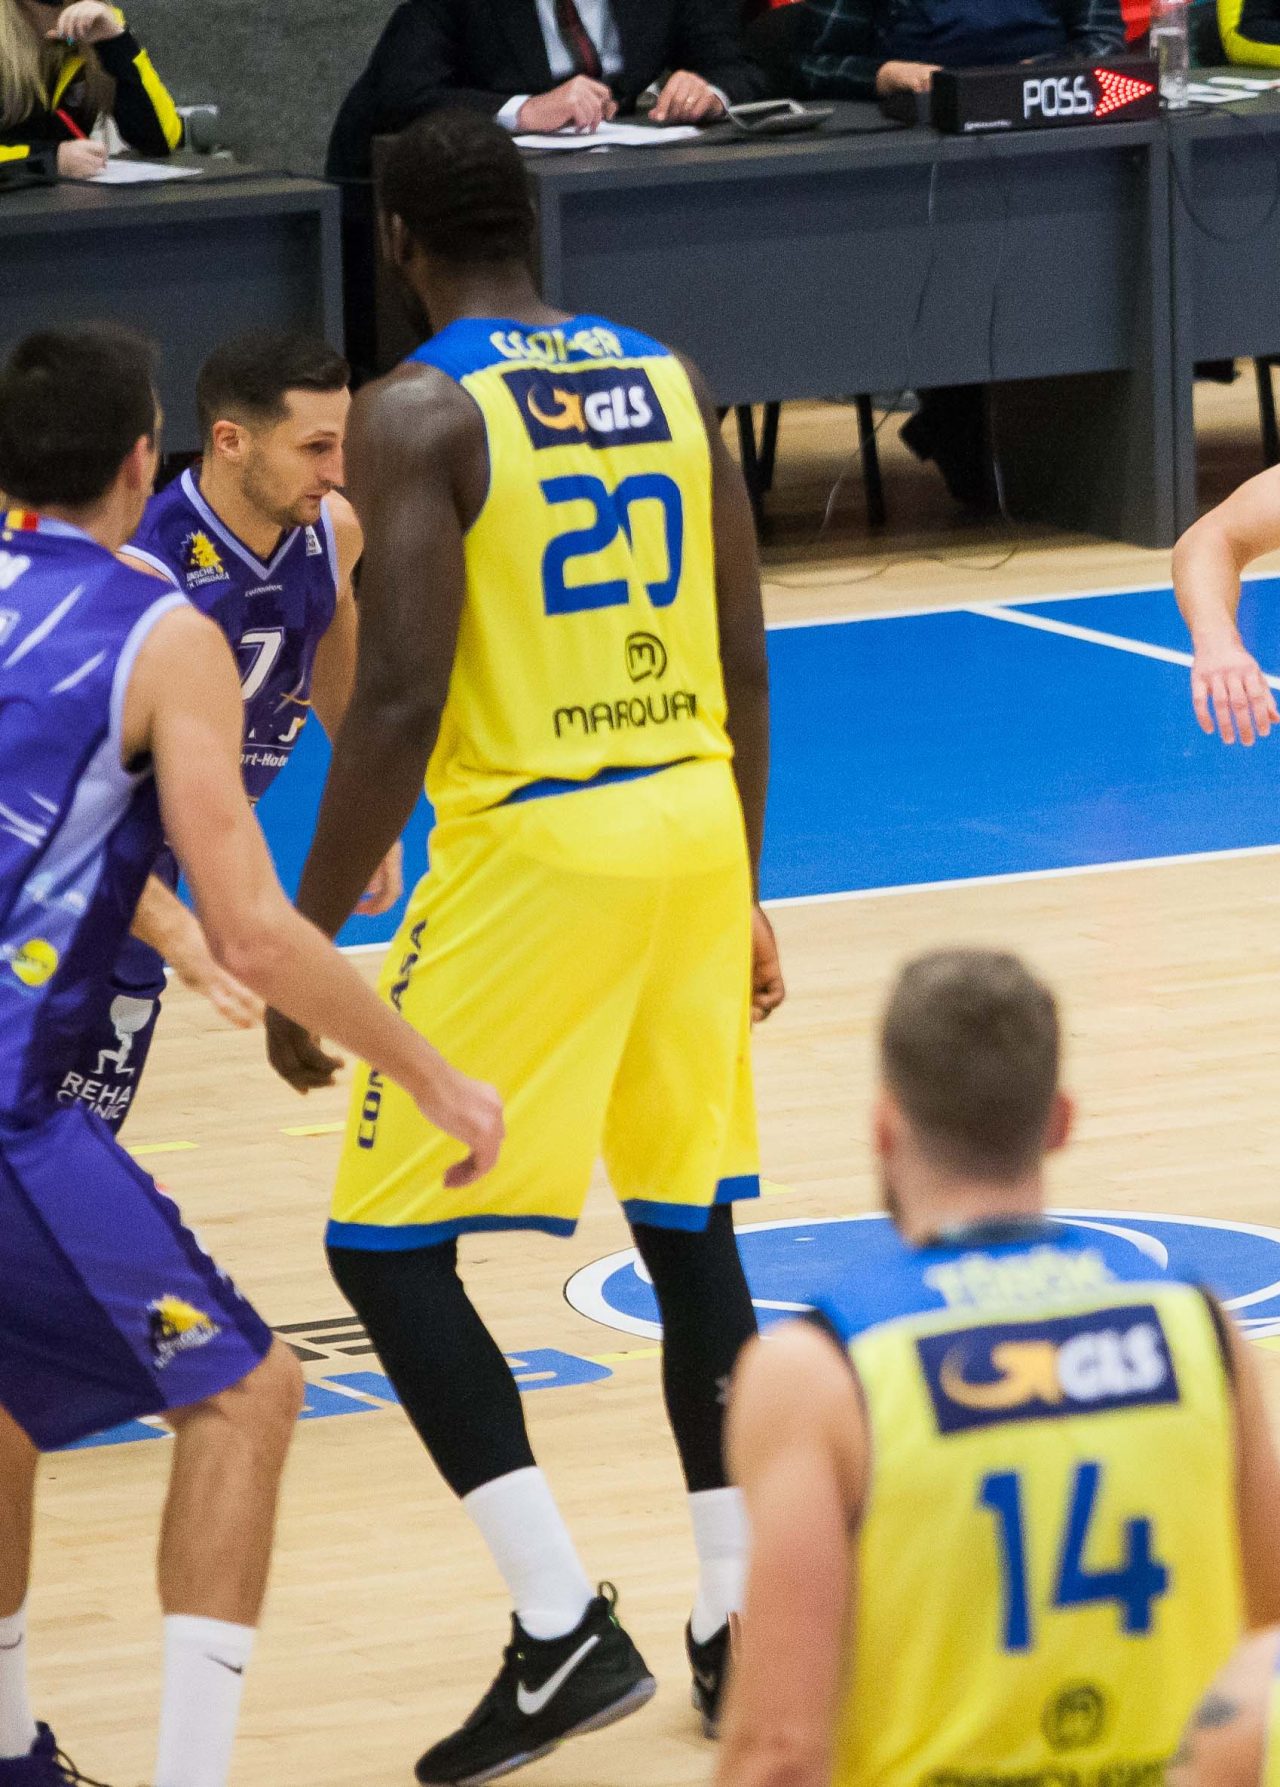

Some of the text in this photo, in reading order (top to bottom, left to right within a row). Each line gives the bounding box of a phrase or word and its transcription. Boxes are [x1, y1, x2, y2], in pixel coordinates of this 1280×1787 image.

[584, 385, 653, 433] GLS
[539, 471, 684, 616] 20
[239, 627, 286, 701] 7
[57, 1089, 127, 1121] CINIC
[61, 1071, 132, 1105] REHA
[1056, 1322, 1167, 1403] GLS
[976, 1461, 1173, 1656] 14
